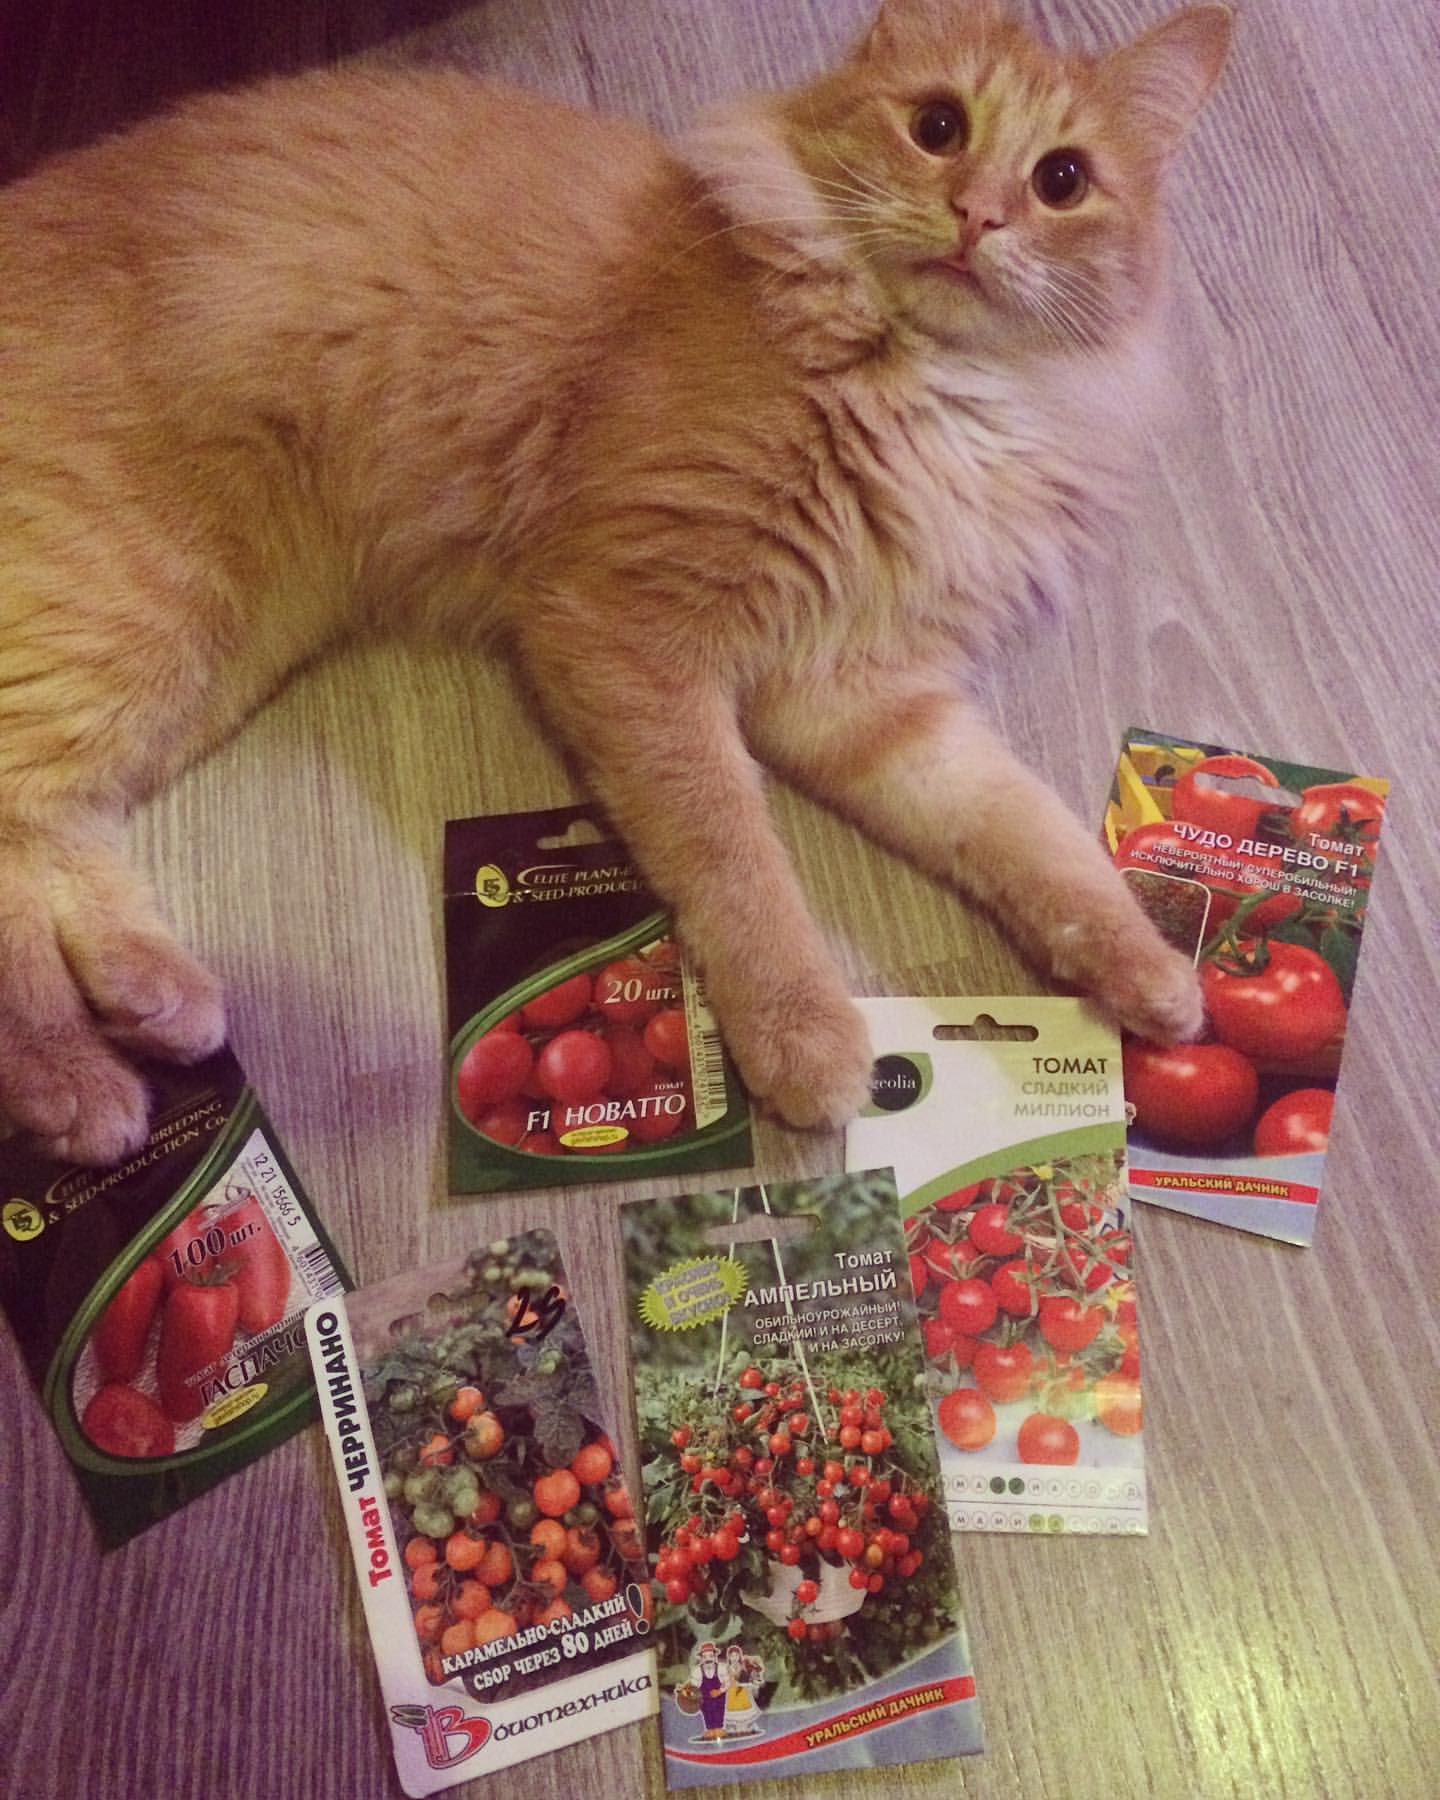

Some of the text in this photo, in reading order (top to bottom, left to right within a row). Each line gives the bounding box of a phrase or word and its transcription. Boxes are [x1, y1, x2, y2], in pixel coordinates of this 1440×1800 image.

[1173, 823, 1359, 877] ЧУДО ДЕРЕВО F1
[1309, 832, 1365, 857] Томат
[1130, 849, 1235, 880] ИСКЛЮЧИТЕЛЬНО
[1237, 873, 1280, 891] ХОРОШ
[1282, 884, 1292, 894] В
[531, 880, 642, 901] SEED-PRODUCT
[604, 979, 677, 1004] 20 шт.
[1033, 1057, 1108, 1074] ТОМАТ
[1022, 1080, 1109, 1096] СЛАДКИЙ
[527, 1094, 687, 1131] F1 НОВАТТО
[1014, 1103, 1110, 1118] МИЛЛИОН
[261, 1167, 277, 1184] 21
[1155, 1176, 1289, 1196] УРАЛЬСКИЙ ДАЧНИК
[169, 1222, 262, 1277] 100 шт.
[834, 1249, 894, 1270] Томат
[744, 1269, 898, 1307] АМПЕЛЬНЫЙ
[831, 1322, 850, 1335] НА
[822, 1339, 840, 1352] НА
[843, 1331, 905, 1349] ЗАСОЛКУ!
[316, 1311, 393, 1587] Томат ЧЕРРИНАНО
[441, 1596, 628, 1675] КАРАМЕЛЬНО-СЛАДКИЙ
[473, 1665, 512, 1690] СБОР
[514, 1647, 561, 1676] ЧЕРЕЗ
[561, 1631, 590, 1659] 80
[806, 1687, 946, 1747] УРАЛЬСКИЙ ДАЧНИК
